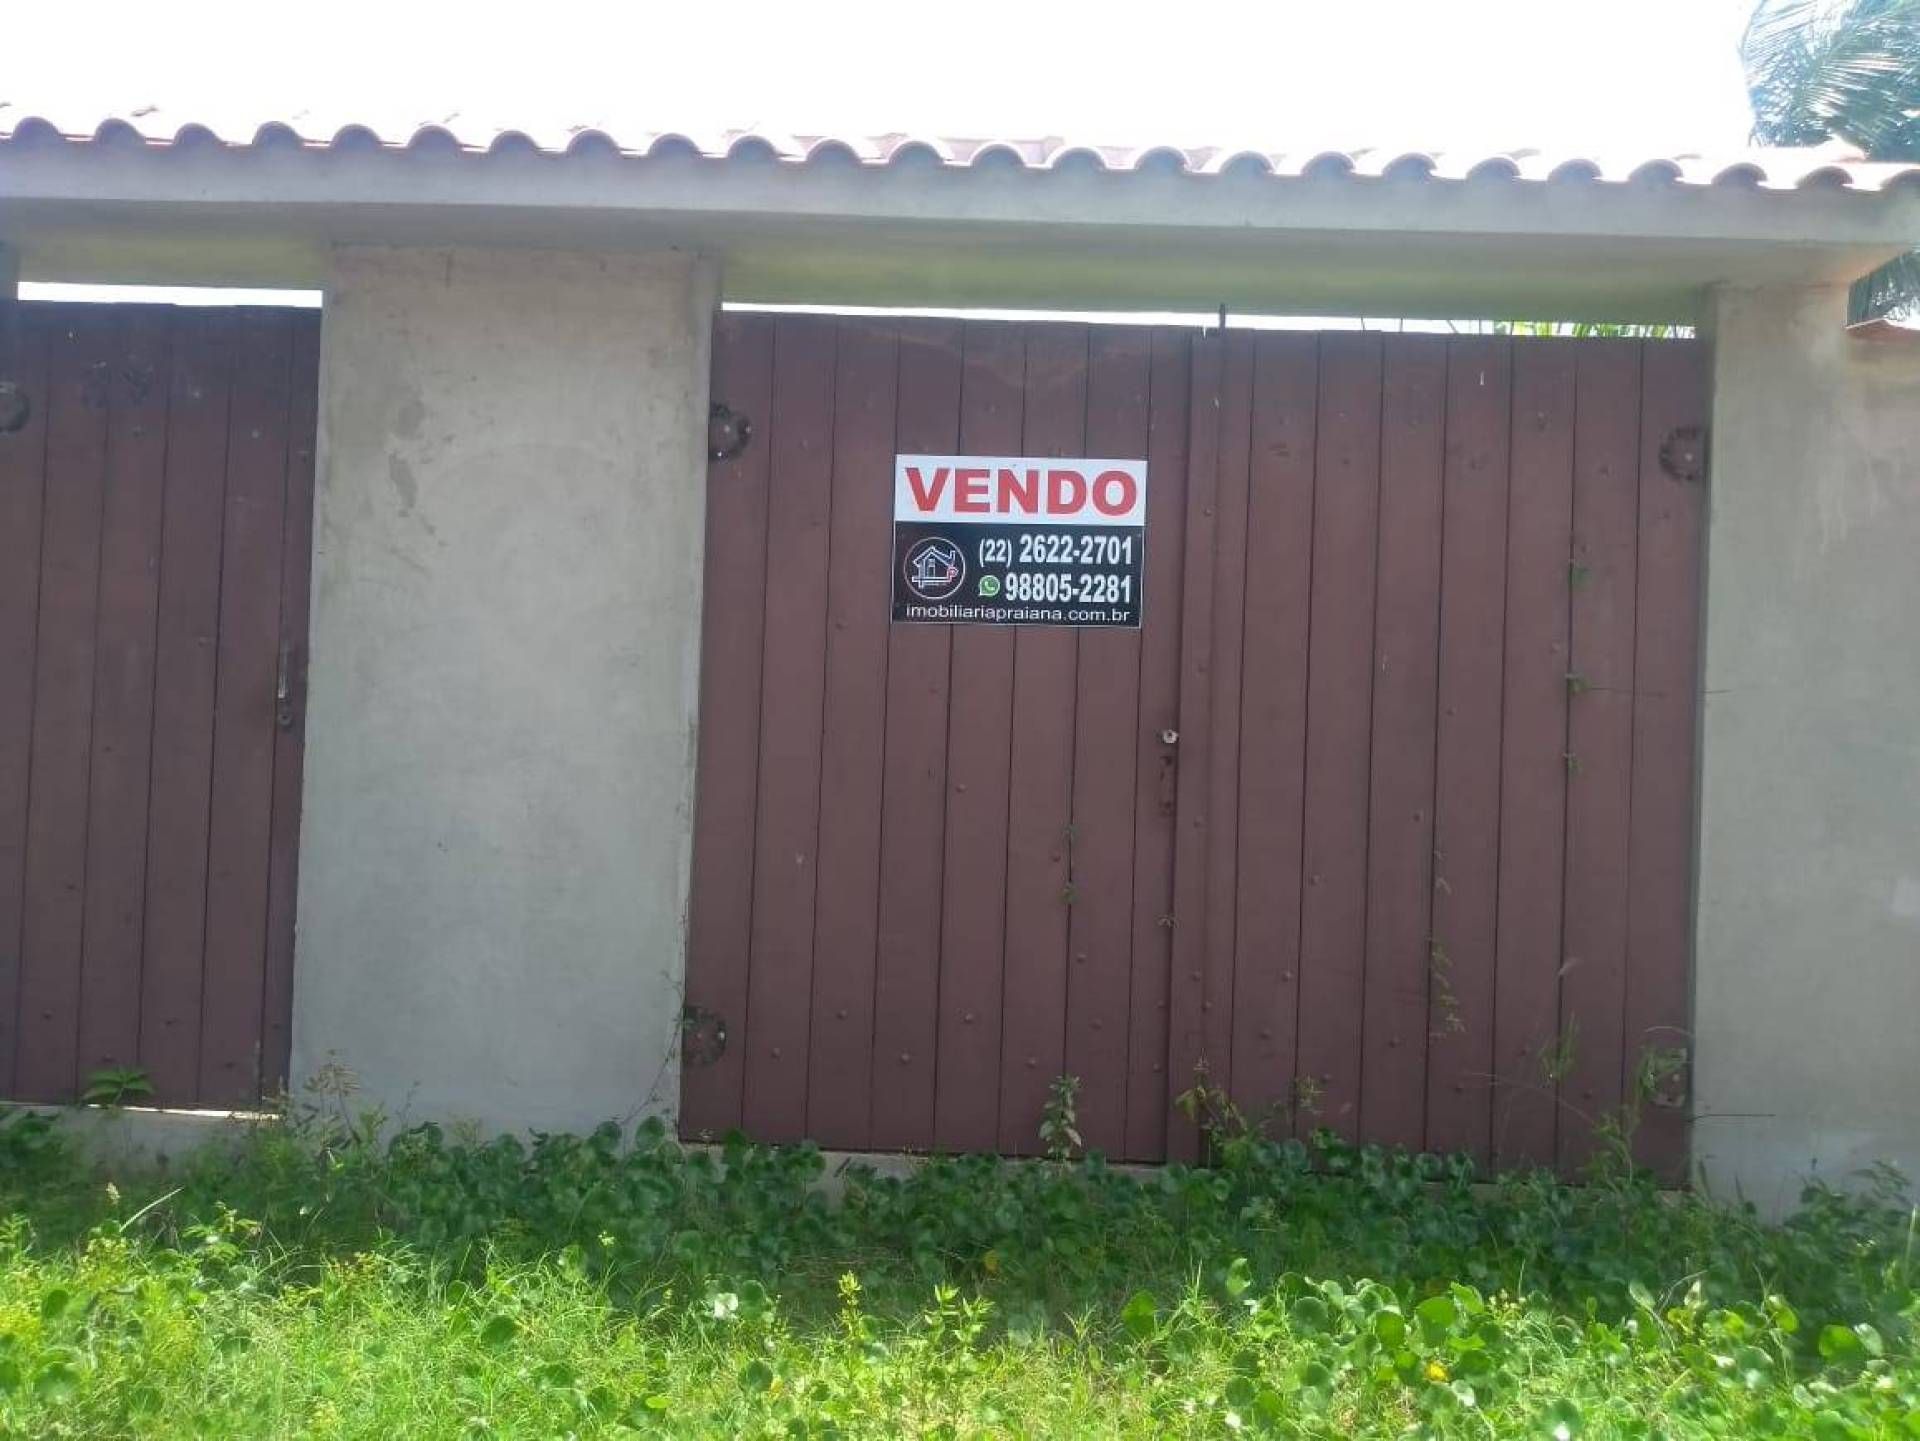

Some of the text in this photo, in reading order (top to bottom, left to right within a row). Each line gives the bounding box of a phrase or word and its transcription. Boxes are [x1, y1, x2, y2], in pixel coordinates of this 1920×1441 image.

[905, 467, 1137, 516] VENDO
[979, 534, 1132, 567] (22) 2622-2701
[1005, 572, 1131, 603] 98805-2281
[906, 604, 1131, 622] imobiliariapraiana.com.br
